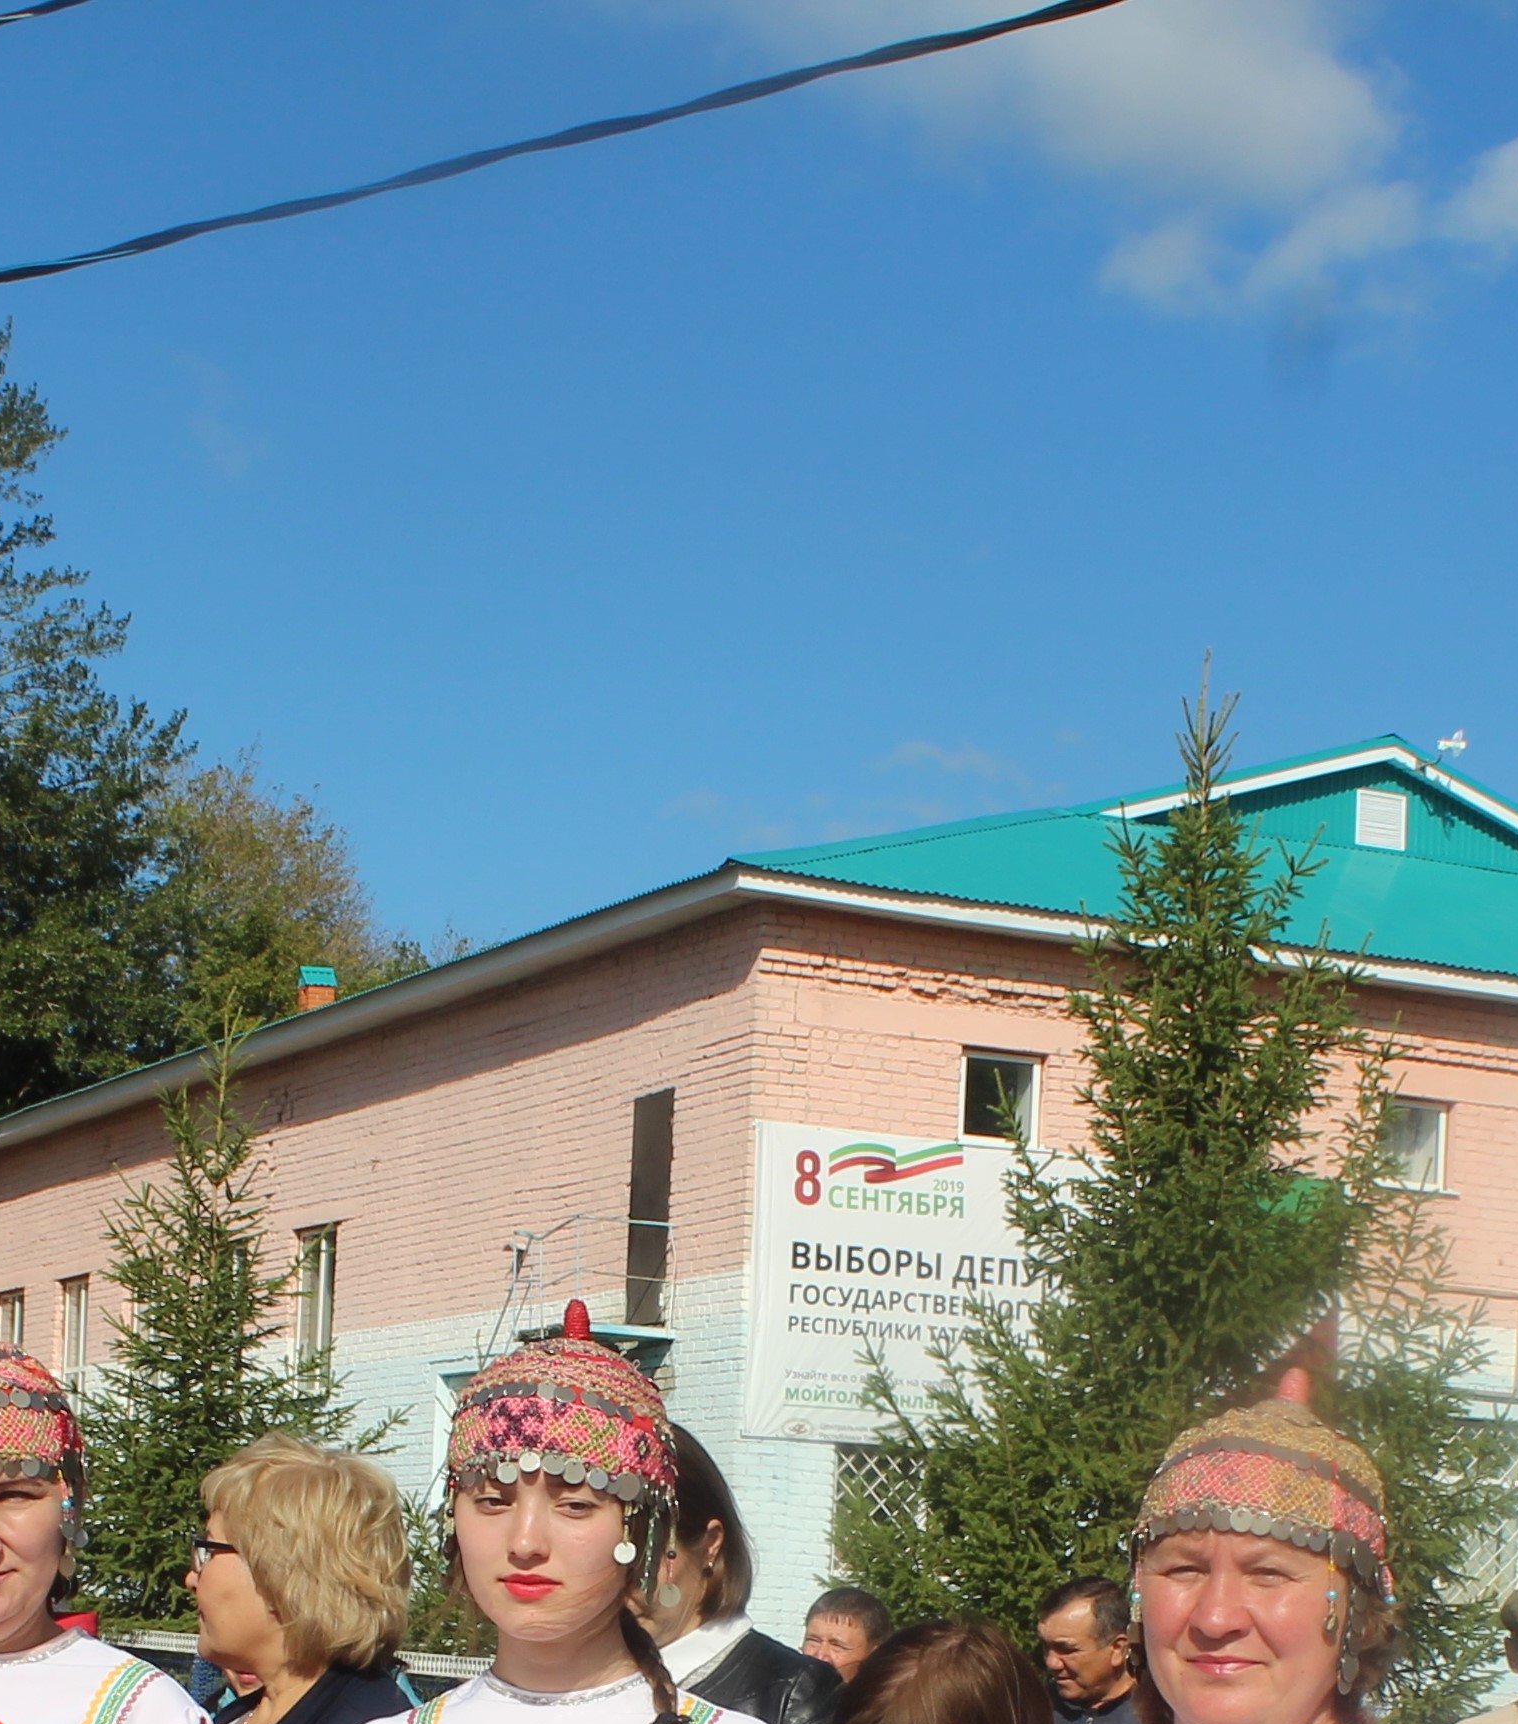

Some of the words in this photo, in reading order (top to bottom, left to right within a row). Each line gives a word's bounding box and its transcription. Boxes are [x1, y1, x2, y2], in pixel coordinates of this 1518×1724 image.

[794, 1149, 822, 1206] 8
[828, 1184, 965, 1220] СЕНТЯБРЯ
[932, 1178, 965, 1194] 2019
[791, 1240, 943, 1282] ВЫБОРЫ
[787, 1315, 922, 1342] РЕСПУБЛИКИ
